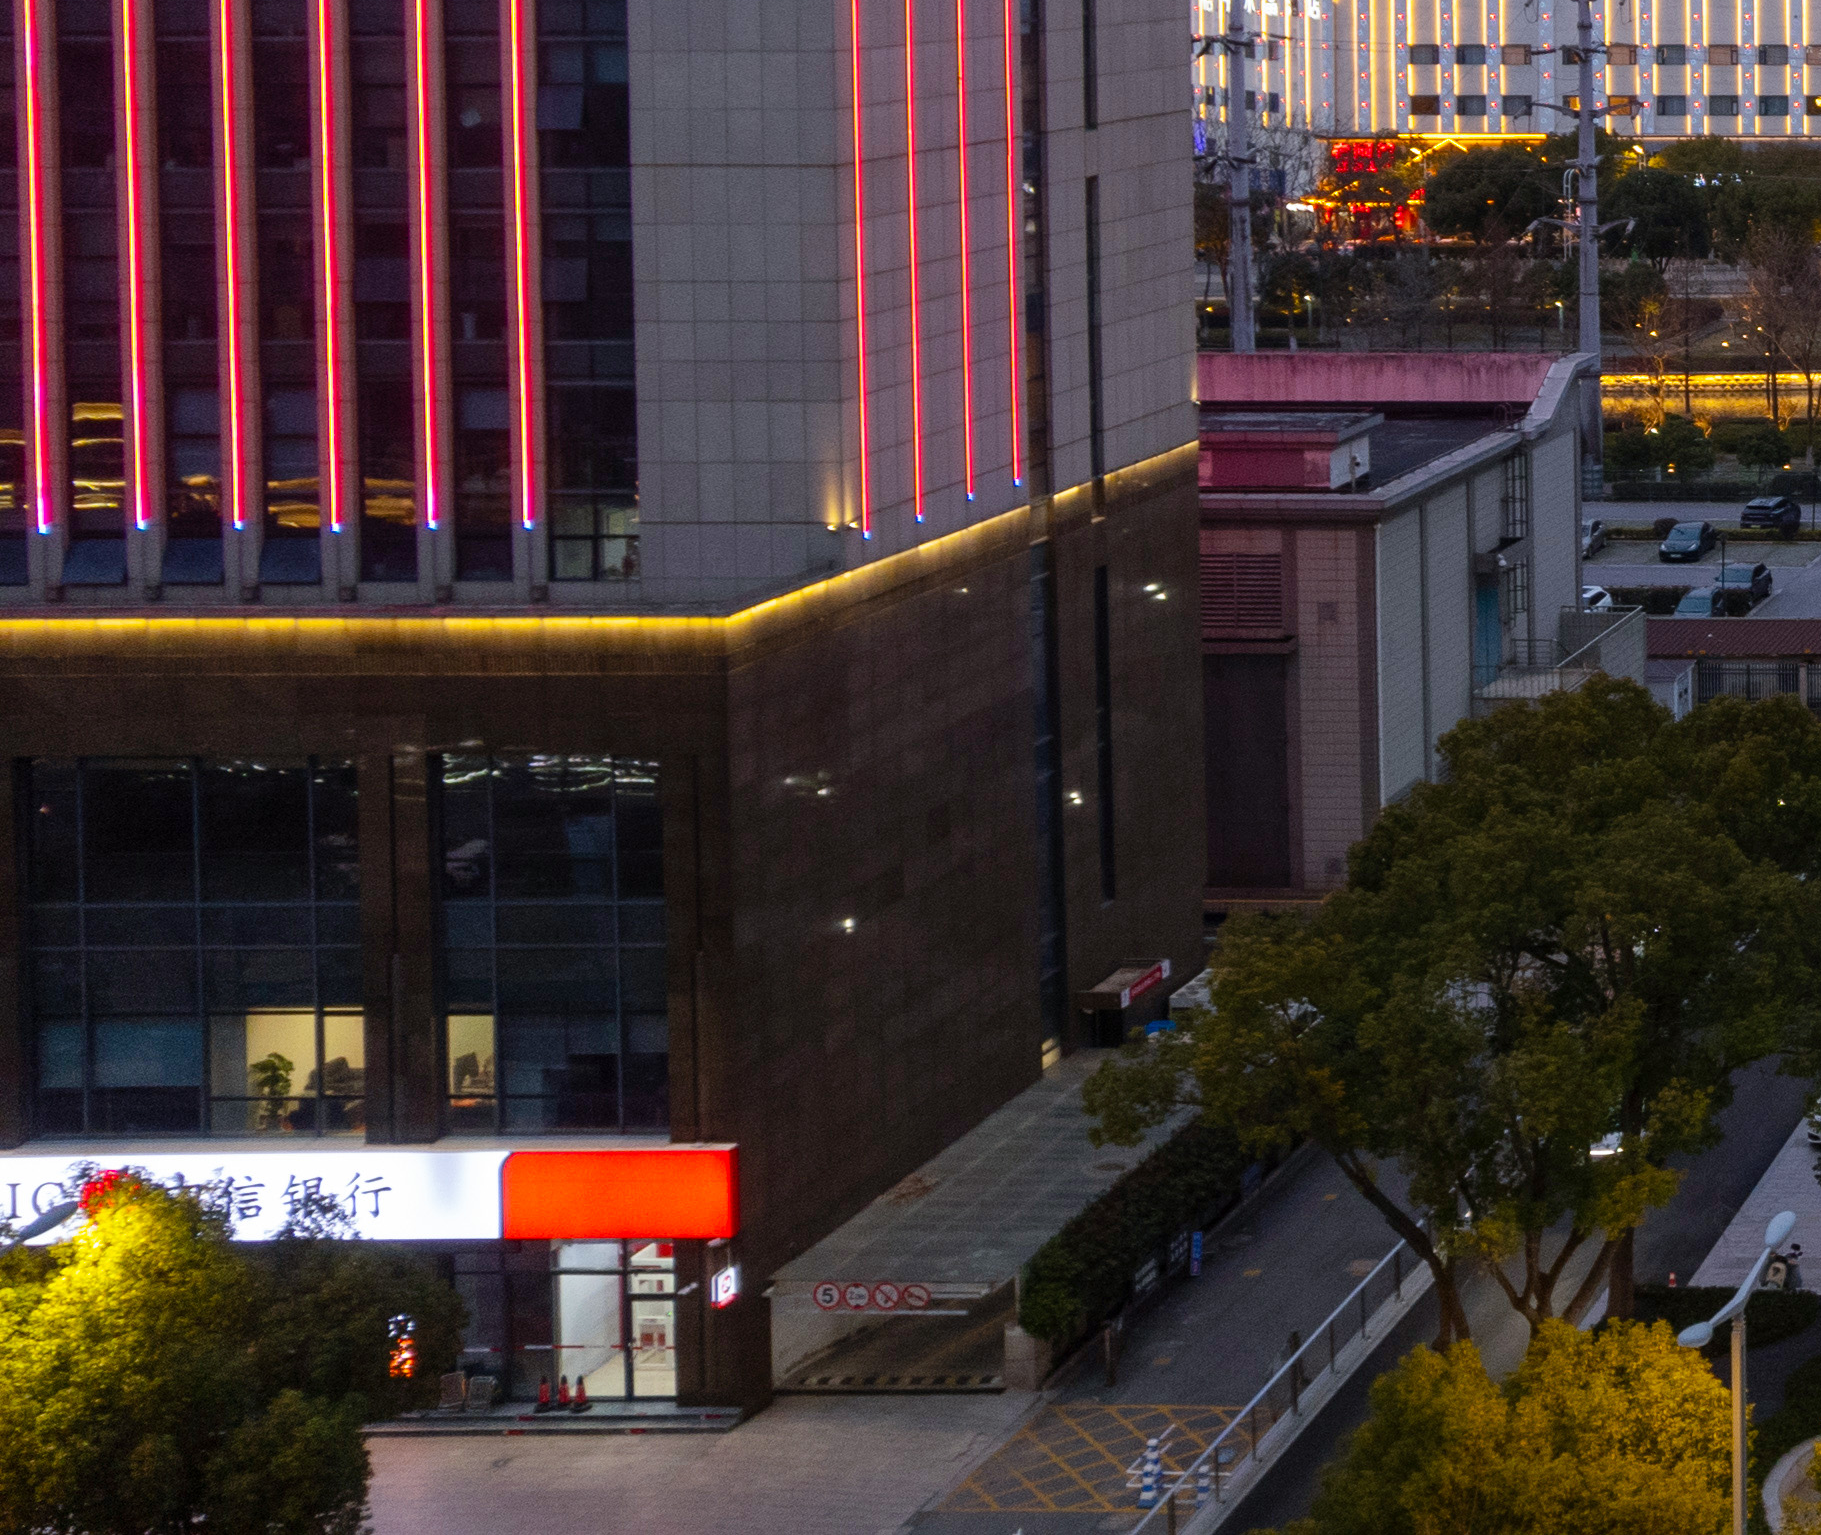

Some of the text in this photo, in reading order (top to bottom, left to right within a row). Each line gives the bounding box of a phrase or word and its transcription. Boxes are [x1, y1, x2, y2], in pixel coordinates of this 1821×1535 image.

[163, 1171, 393, 1220] 信银行
[822, 1287, 834, 1304] 5
